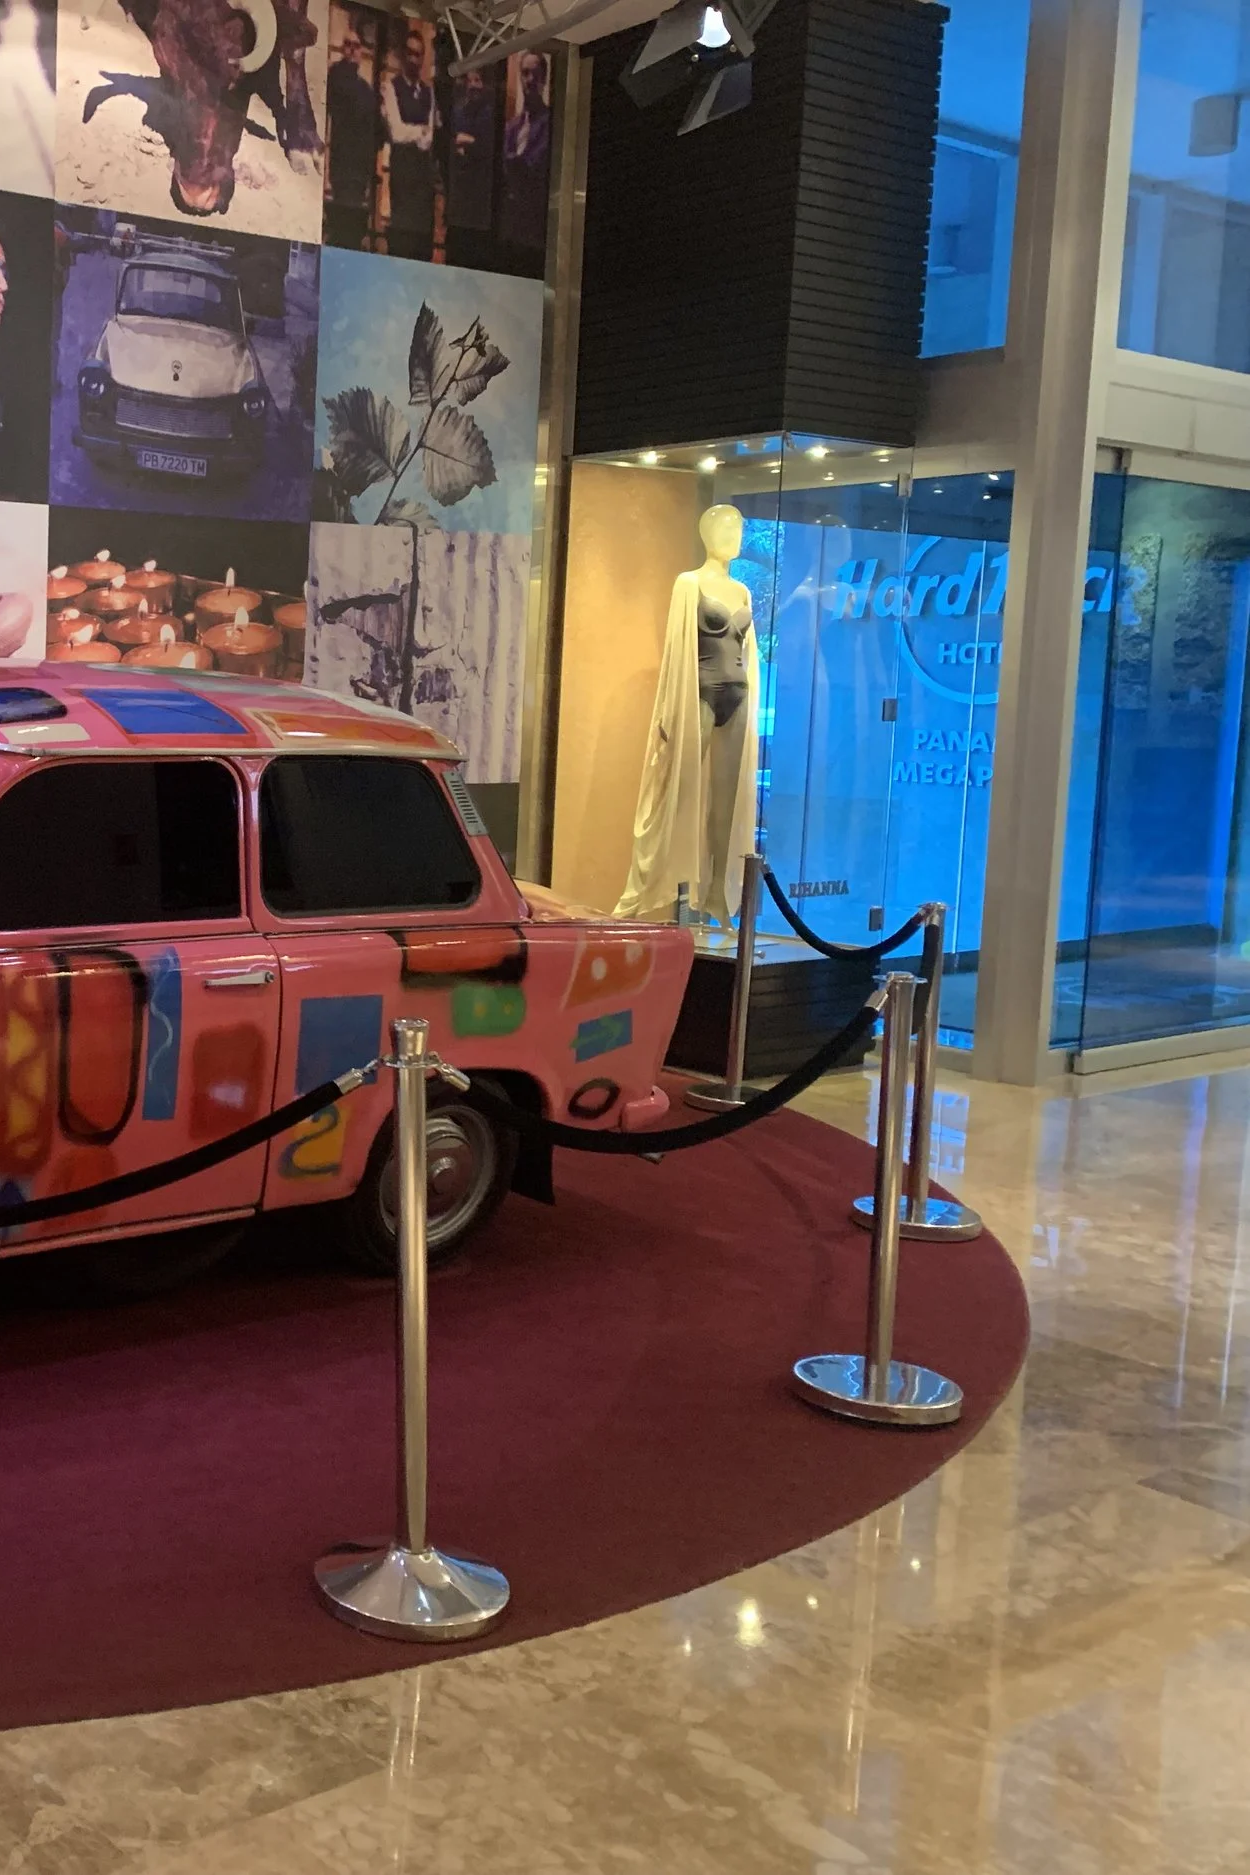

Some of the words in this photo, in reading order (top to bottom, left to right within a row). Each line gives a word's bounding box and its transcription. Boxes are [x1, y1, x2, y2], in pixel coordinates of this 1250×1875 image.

[160, 456, 188, 472] 7220
[832, 552, 984, 620] Hard
[938, 642, 1002, 664] HOT
[914, 729, 996, 753] PANA
[893, 761, 993, 787] MEGAP
[789, 880, 849, 898] RIHANNA
